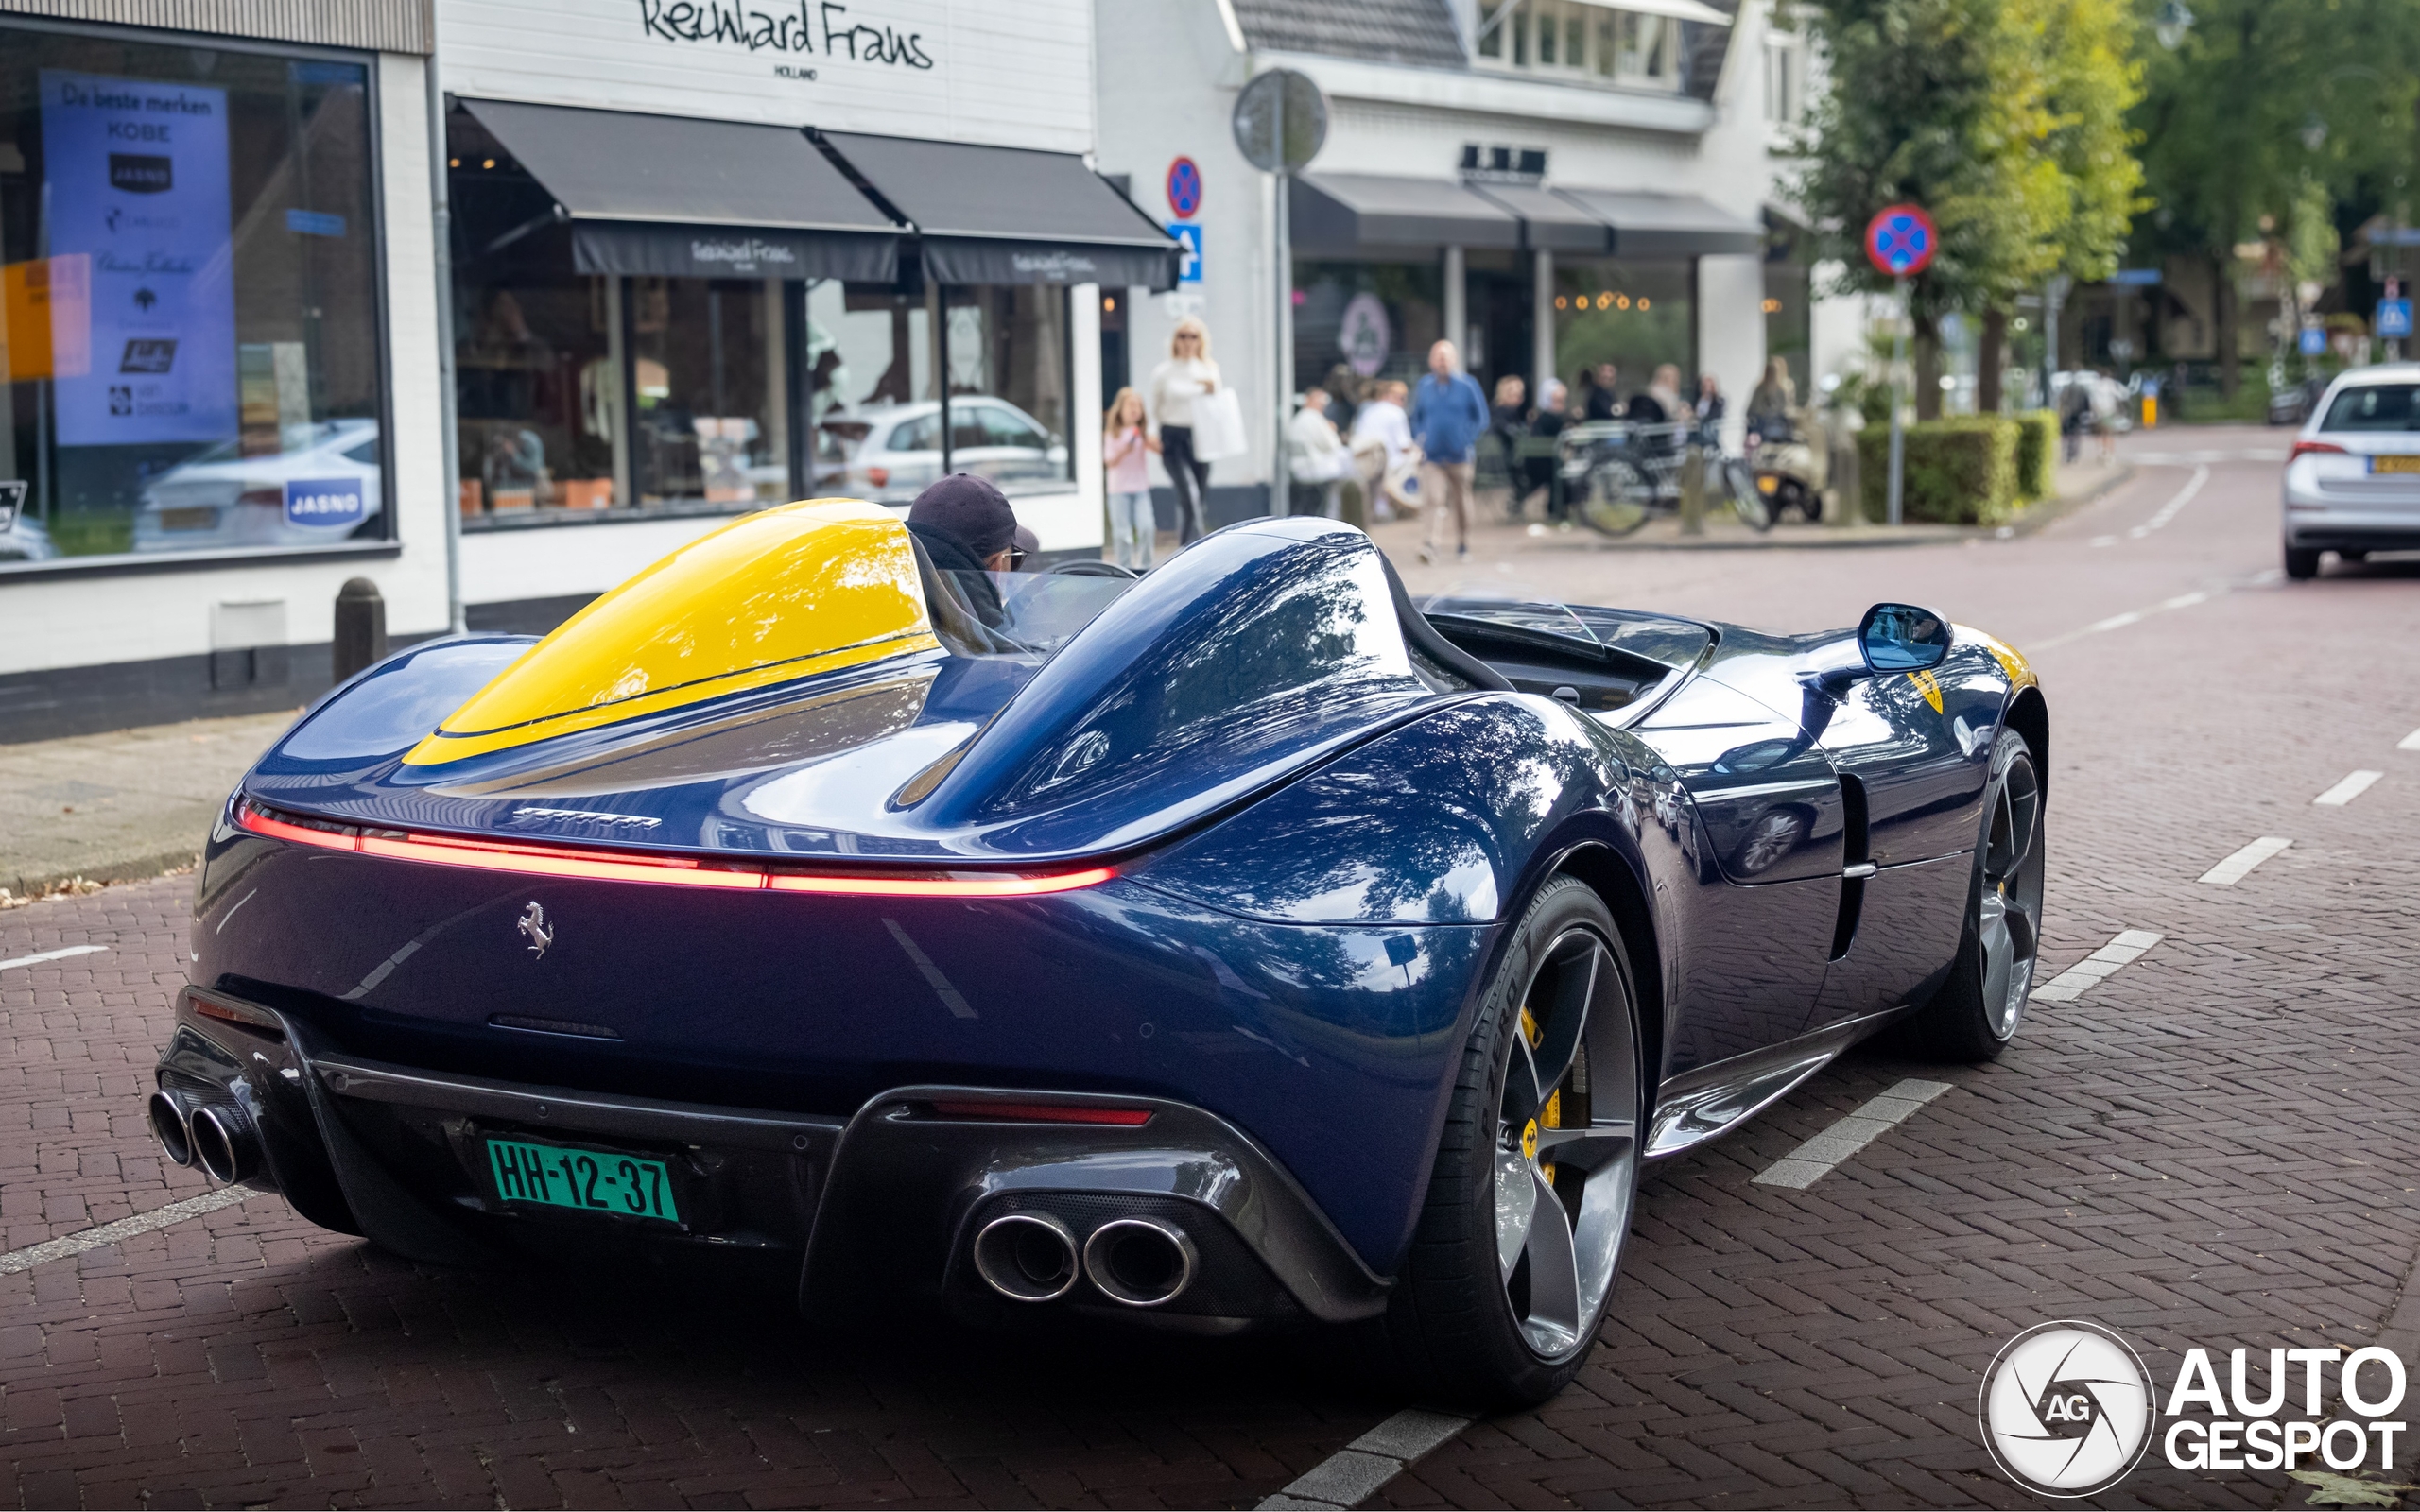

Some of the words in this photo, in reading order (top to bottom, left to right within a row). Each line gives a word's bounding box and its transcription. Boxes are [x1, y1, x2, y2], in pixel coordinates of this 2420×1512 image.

[821, 1, 934, 69] Frans
[774, 64, 818, 81] HOLLAND
[61, 81, 88, 106] De
[94, 84, 141, 111] beste
[145, 92, 213, 115] merken
[107, 121, 172, 143] KOBE
[290, 493, 359, 515] JASNO
[1486, 976, 1518, 1097] ZERO
[493, 1143, 665, 1217] HH-12-37
